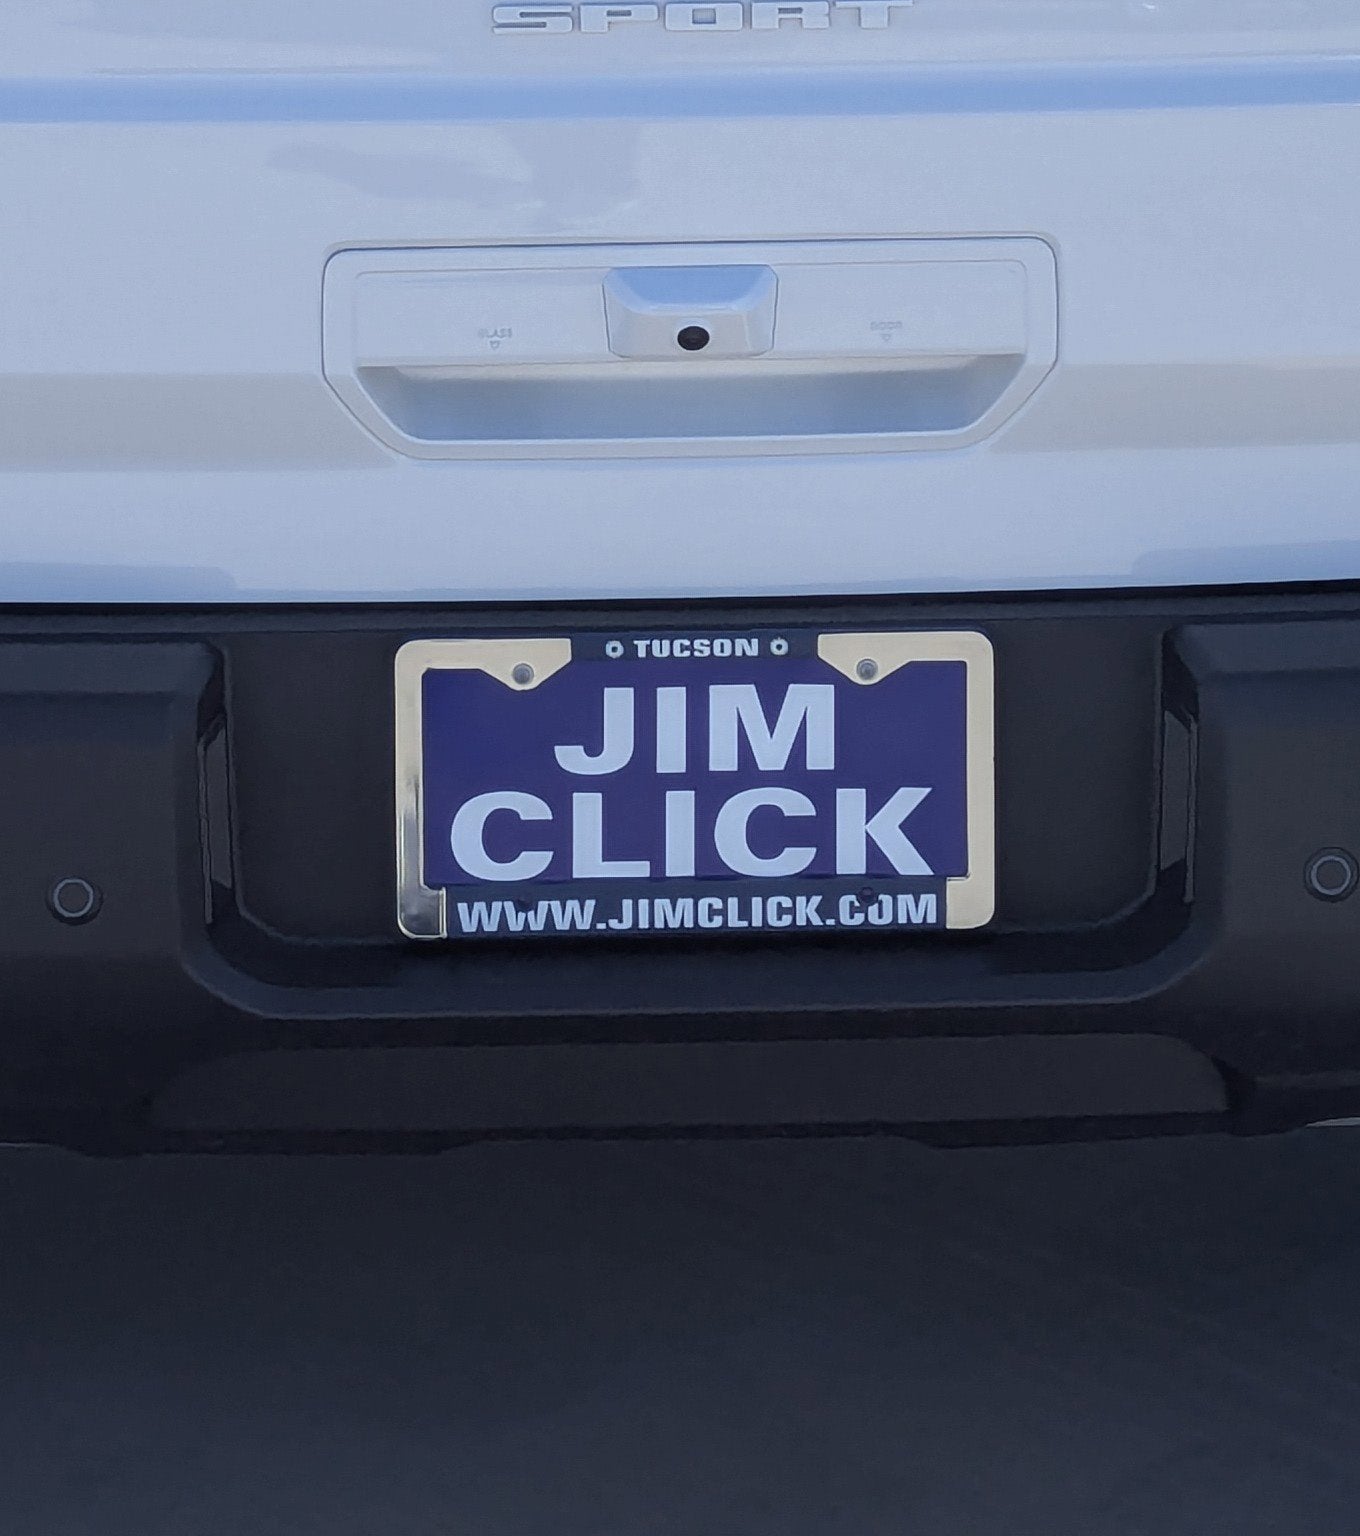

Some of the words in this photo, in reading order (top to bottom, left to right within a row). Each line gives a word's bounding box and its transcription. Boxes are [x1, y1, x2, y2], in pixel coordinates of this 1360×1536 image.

[634, 638, 759, 659] TUCSON
[554, 683, 835, 775] JIM
[450, 787, 934, 881] CLICK
[457, 893, 937, 932] WWW.JIMCLICK.COM
